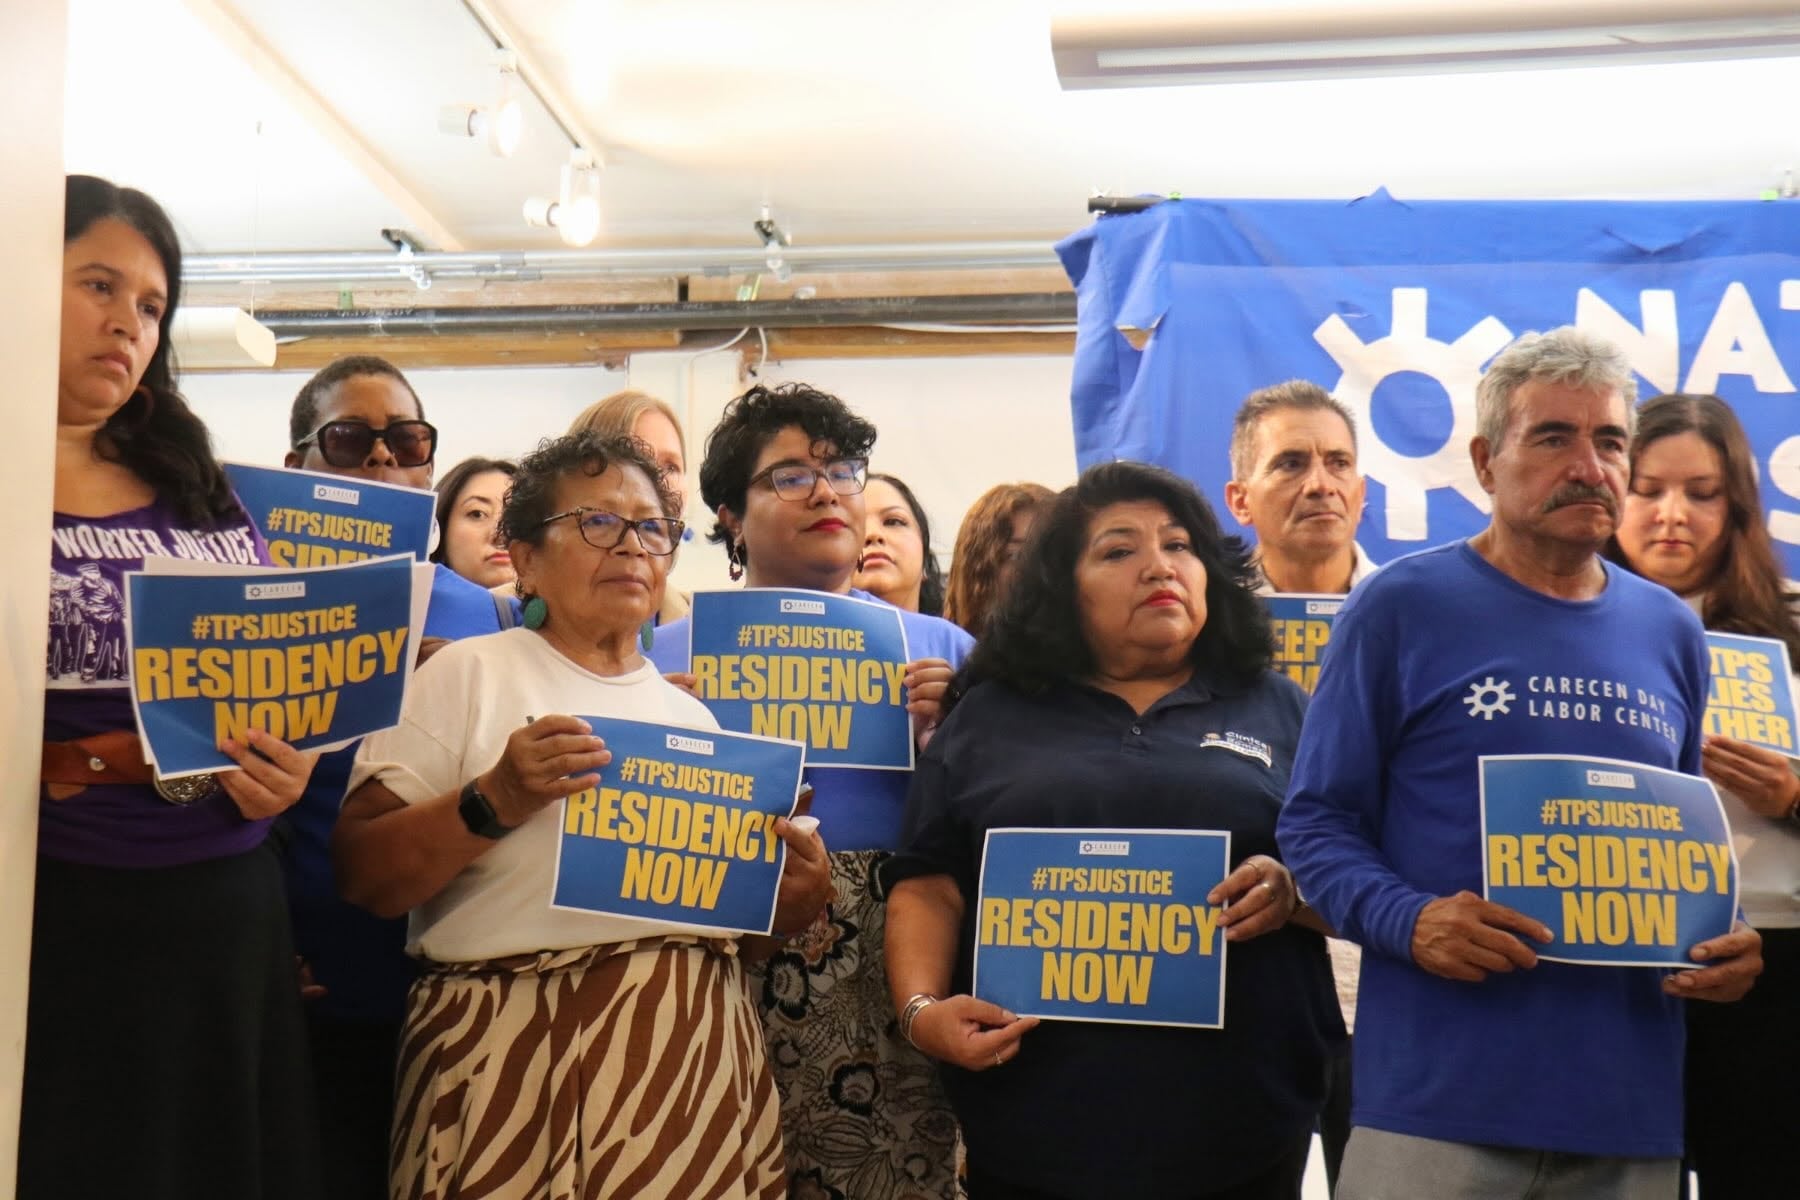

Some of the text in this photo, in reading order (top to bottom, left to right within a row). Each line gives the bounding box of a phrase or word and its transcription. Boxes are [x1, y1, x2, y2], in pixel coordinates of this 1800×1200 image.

[1576, 280, 1800, 394] NA
[52, 525, 172, 559] WORKER
[169, 526, 260, 564] JUSTICE
[267, 508, 393, 547] #TPSJUSTICE
[192, 605, 356, 640] #TPSJUSTICE
[738, 624, 865, 652] #TPSJUSTICE
[1270, 619, 1330, 662] EEP
[134, 627, 408, 703] RESIDENCY
[693, 655, 907, 706] RESIDENCY
[1528, 676, 1666, 715] CARECEN DAY
[215, 691, 339, 751] NOW
[751, 703, 852, 750] NOW
[1528, 700, 1677, 745] LABOR CENTER
[620, 757, 754, 801] #TPSJUSTICE
[565, 788, 788, 864] RESIDENCY
[1541, 799, 1682, 832] #TPSJUSTICE
[620, 848, 728, 911] NOW
[1031, 867, 1173, 896] #TPSJUSTICE
[1488, 834, 1730, 894] RESIDENCY
[980, 898, 1223, 956] RESIDENCY
[1562, 891, 1677, 947] NOW
[1040, 952, 1154, 1006] NOW
